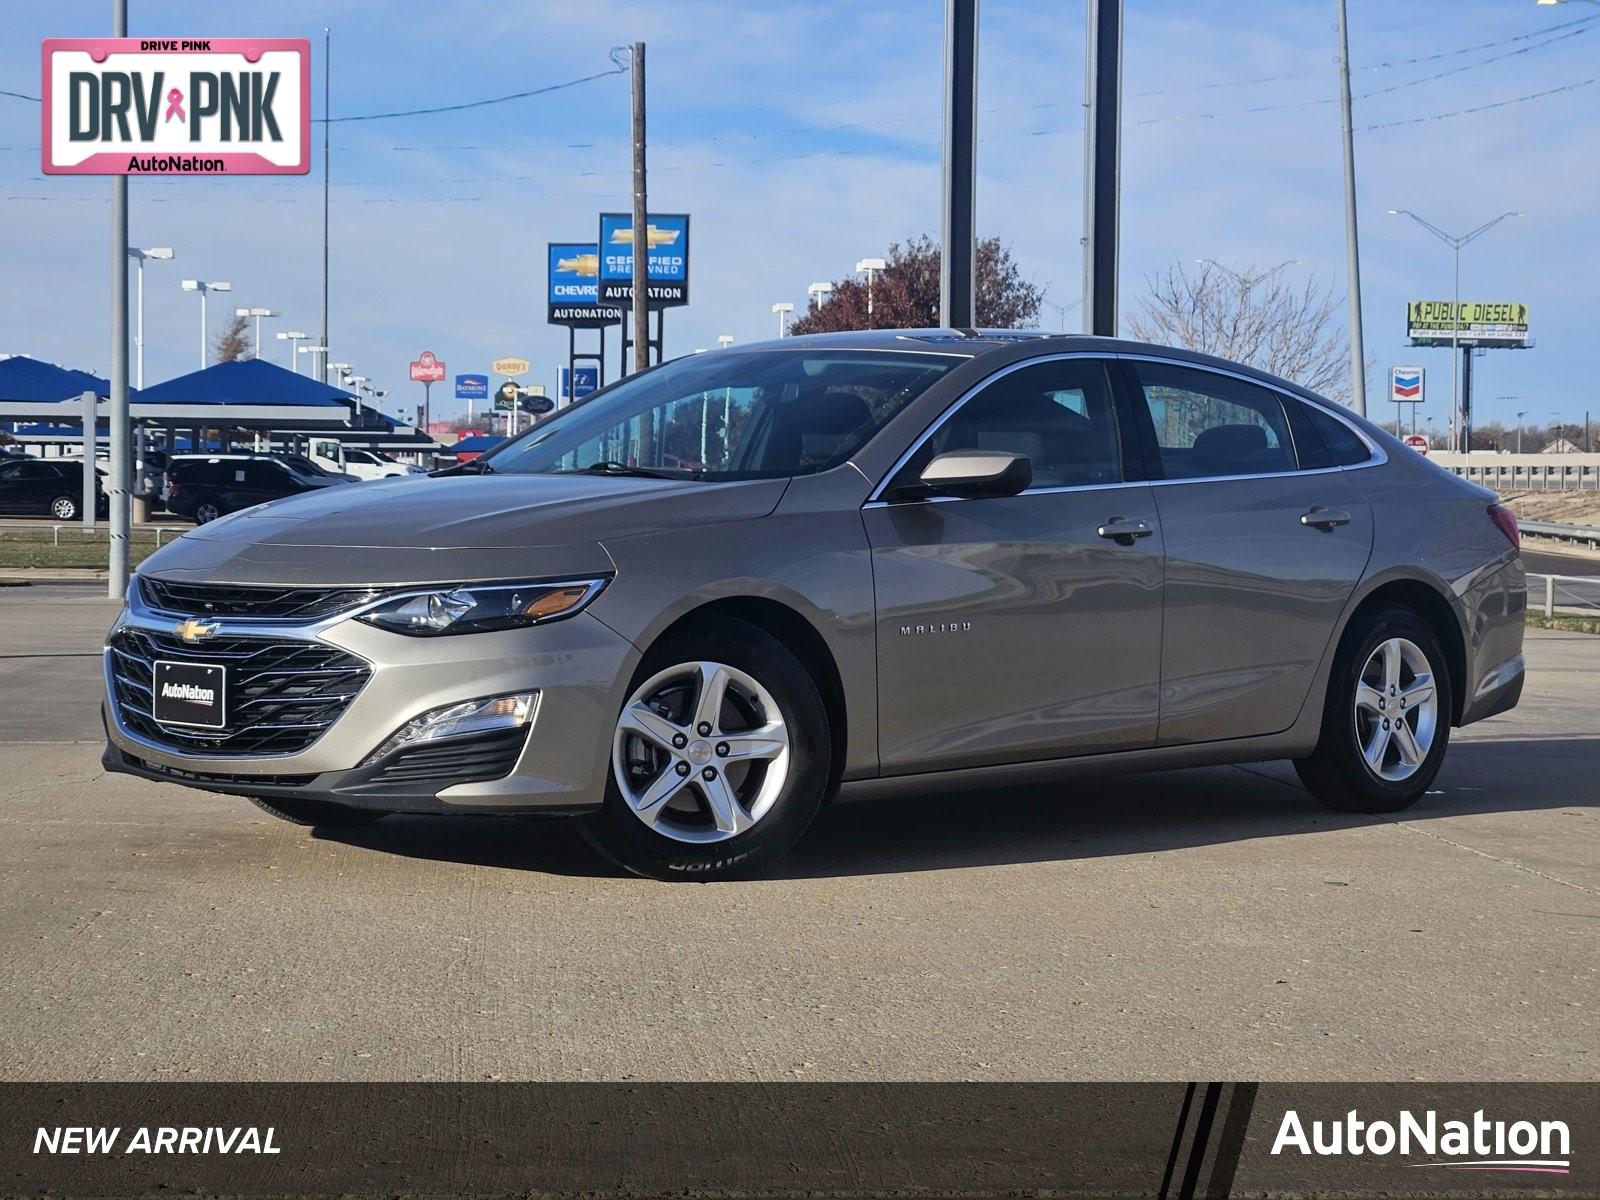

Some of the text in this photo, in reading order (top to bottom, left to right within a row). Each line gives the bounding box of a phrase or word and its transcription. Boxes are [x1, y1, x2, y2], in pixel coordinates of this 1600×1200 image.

[553, 308, 621, 318] AUTONATION
[1424, 303, 1515, 321] PUBLIC DIESEL
[496, 362, 526, 372] Denny's
[900, 622, 971, 635] MALIBU
[162, 682, 214, 701] AutoNation
